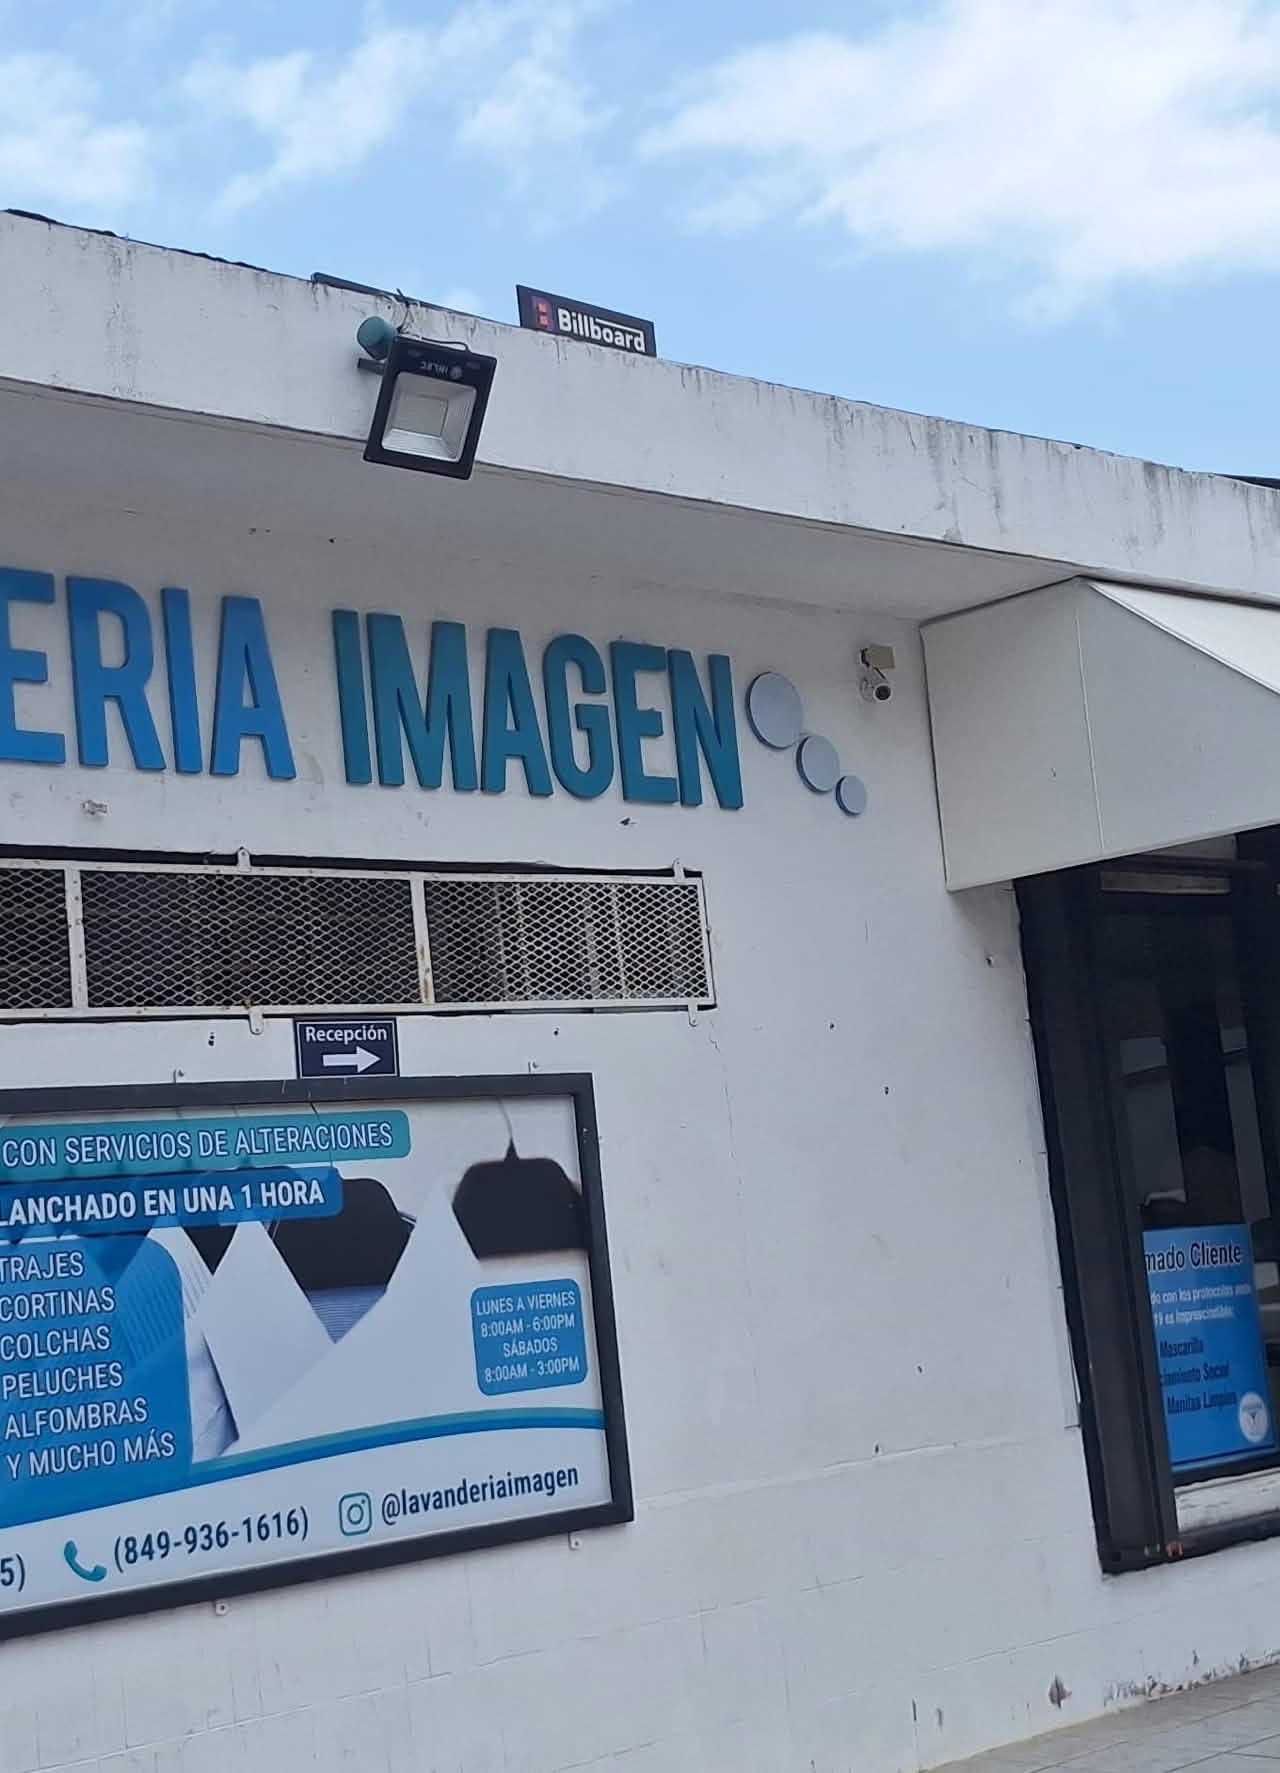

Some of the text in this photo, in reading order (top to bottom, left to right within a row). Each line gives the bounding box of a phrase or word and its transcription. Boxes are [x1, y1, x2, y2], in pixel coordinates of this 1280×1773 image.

[558, 307, 646, 353] Billboard
[331, 608, 744, 810] IMAGEN
[305, 1024, 387, 1045] Recepción
[2, 1122, 393, 1167] CON SERVICIOS DE ALTERACIONES
[144, 1188, 175, 1216] EN
[183, 1184, 235, 1214] UNA
[240, 1183, 252, 1209] 1
[261, 1179, 325, 1207] HORA
[1190, 1240, 1242, 1268] Cliente
[476, 1290, 576, 1316] LUNES A VIERNES
[0, 1325, 111, 1361] COLCHAS
[481, 1318, 524, 1338] 8:00AM
[533, 1312, 575, 1332] 6:00PM
[503, 1336, 558, 1358] SÁBADOS
[1160, 1337, 1204, 1358] Mascarilla
[2, 1363, 123, 1400] PELUCHES
[484, 1363, 528, 1383] 8:00AM
[537, 1356, 580, 1376] 3:00PM
[4, 1397, 148, 1440] ALFOMBRAS
[7, 1432, 176, 1480] Y MUCHO MÁS
[381, 1464, 579, 1525] @lavanderiaimagen
[113, 1505, 309, 1574] (849-936-1616)
